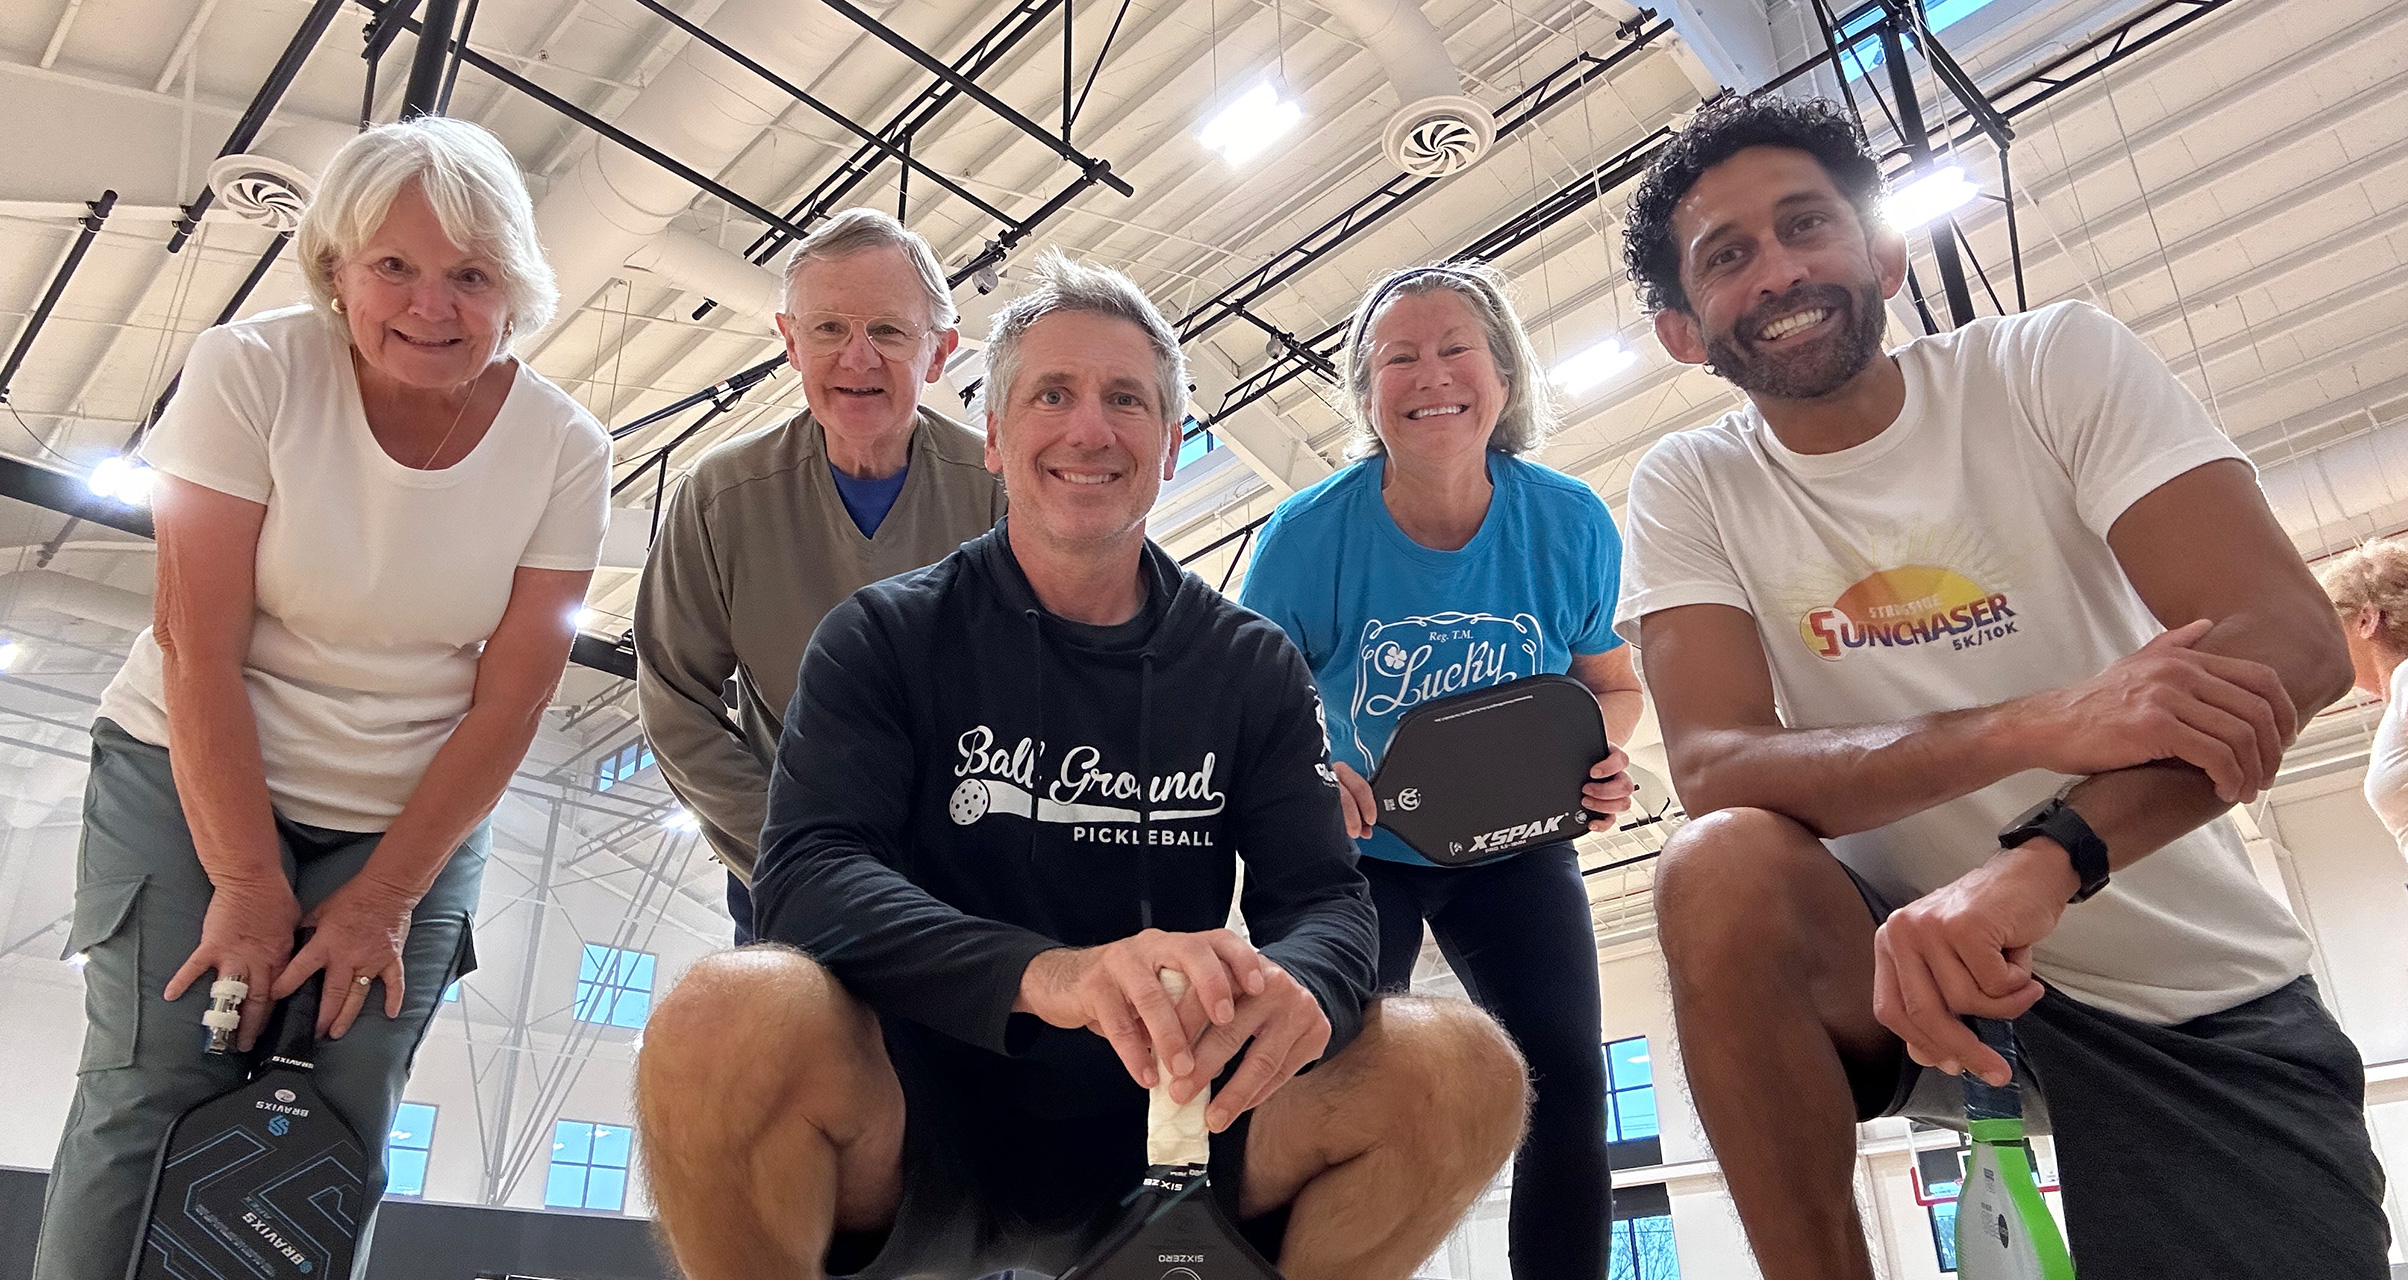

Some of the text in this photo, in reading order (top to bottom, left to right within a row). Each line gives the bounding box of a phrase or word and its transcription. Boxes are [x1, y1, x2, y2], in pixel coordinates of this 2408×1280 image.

[1428, 630, 1474, 643] Reg. T.M.
[1809, 592, 2016, 657] SUNCHASER
[1952, 621, 2019, 651] 5K/10K
[1365, 640, 1517, 716] Lucky
[954, 725, 1225, 806] Ball Ground
[1074, 827, 1213, 846] PICKLEBALL
[1468, 814, 1565, 852] XSPAK
[255, 1101, 310, 1118] BRAVIXS
[242, 1212, 305, 1265] BRAVIXS
[1158, 1254, 1204, 1263] SIXZERO
